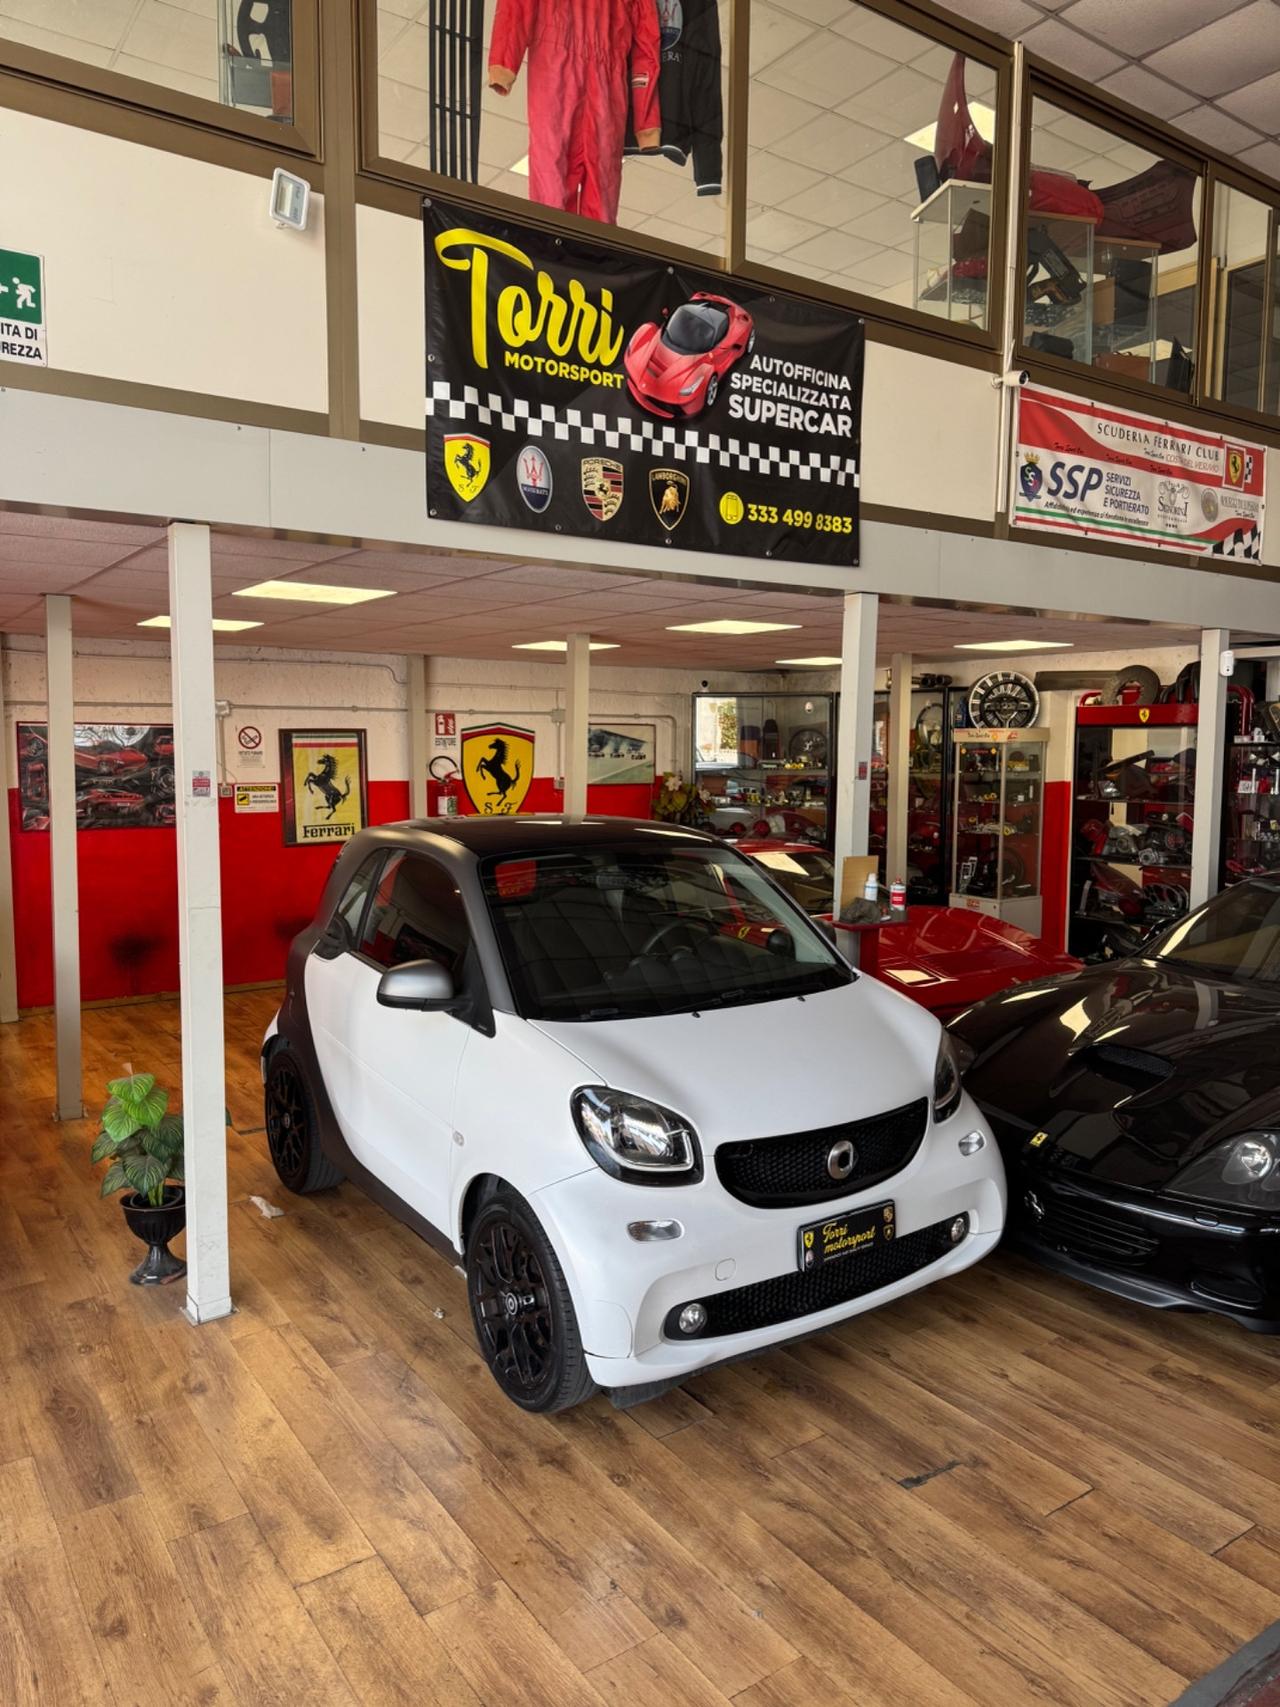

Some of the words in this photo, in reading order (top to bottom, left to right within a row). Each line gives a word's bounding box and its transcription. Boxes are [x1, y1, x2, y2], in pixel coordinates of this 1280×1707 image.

[434, 228, 624, 369] Torri
[0, 322, 21, 338] ITA
[25, 327, 38, 340] DI
[0, 341, 42, 360] REZZA
[505, 351, 624, 389] MOTORSPORT
[750, 354, 852, 391] AUTOFFICINA
[730, 372, 852, 411] SPECIALIZZATA
[728, 394, 853, 438] SUPERCAR
[1097, 422, 1150, 445] SCUDERIA
[1153, 436, 1192, 455] FERRARI
[1196, 446, 1219, 461] CLUB
[1047, 461, 1103, 502] SSP
[1105, 486, 1141, 501] SICUREZZA
[1106, 472, 1132, 487] SERVIZI
[748, 503, 778, 523] 333
[782, 508, 813, 528] 499
[815, 513, 853, 533] 8383
[1103, 498, 1109, 507] E
[1110, 498, 1150, 515] PORTIERATO
[303, 823, 355, 838] Ferrari
[823, 1222, 848, 1243] Torri
[824, 1225, 876, 1254] motorsport
